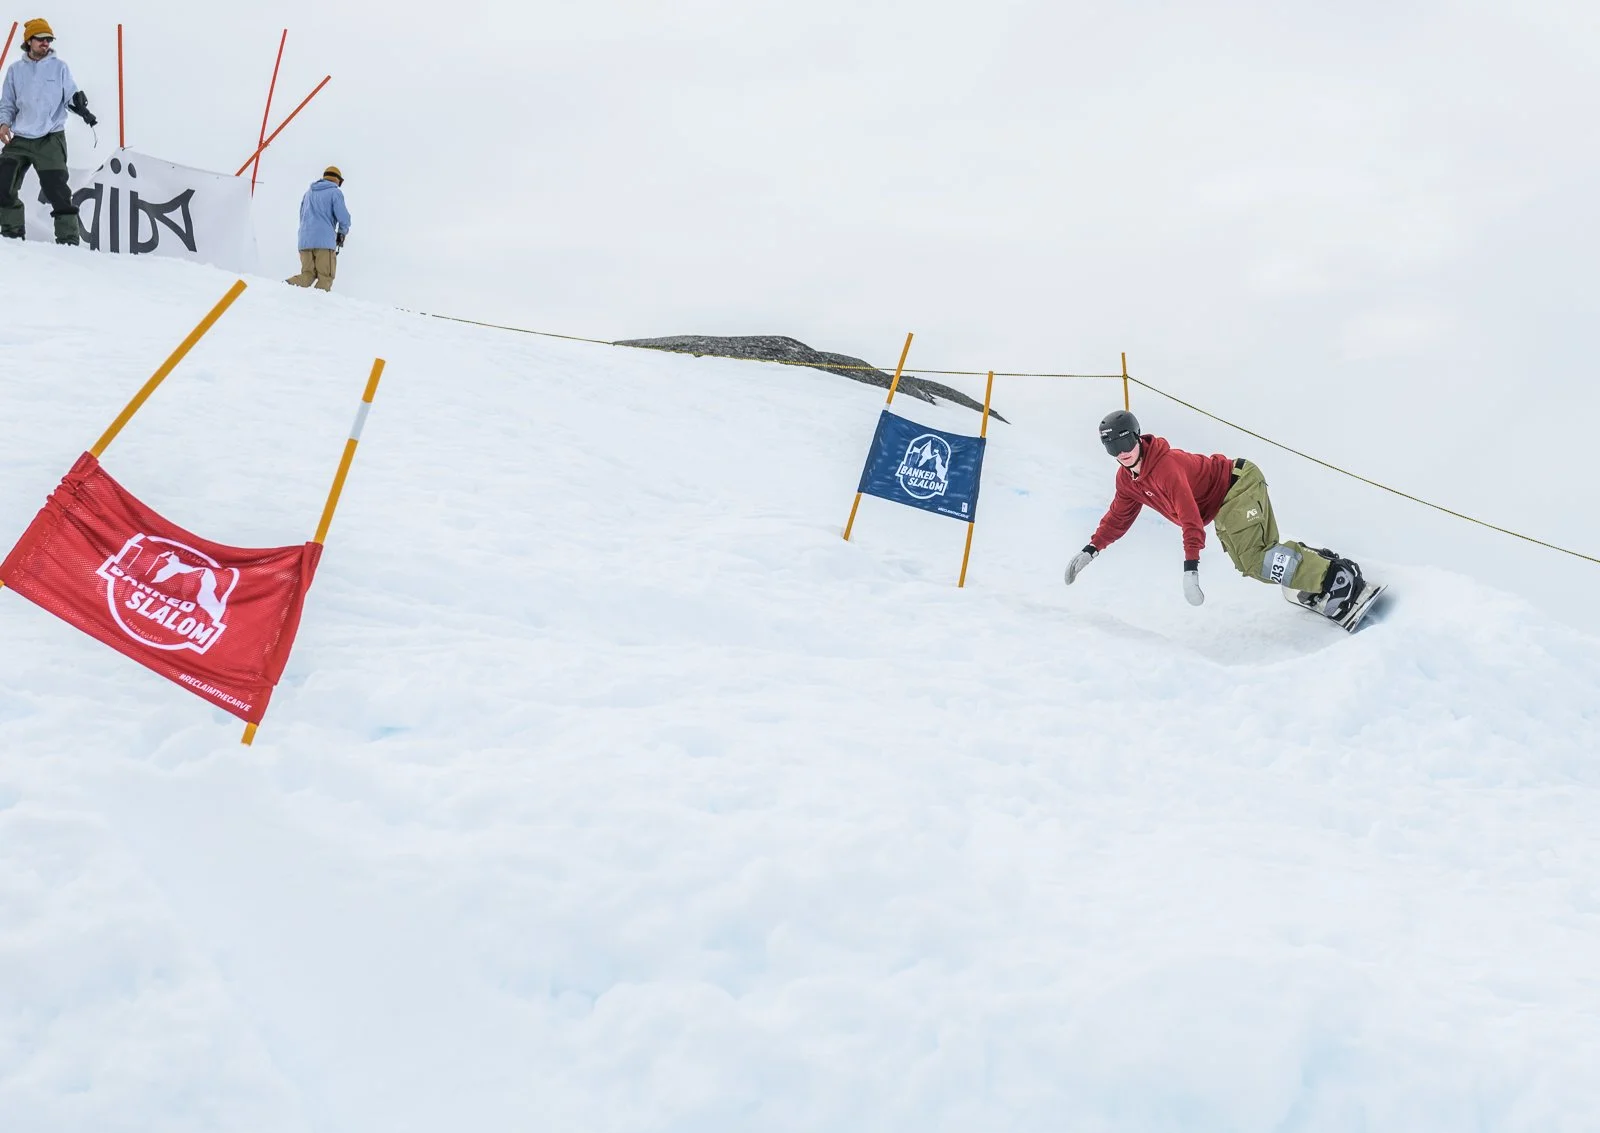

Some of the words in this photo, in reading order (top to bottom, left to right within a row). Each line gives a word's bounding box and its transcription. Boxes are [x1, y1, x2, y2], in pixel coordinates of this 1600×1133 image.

[900, 465, 936, 481] BANKED
[907, 477, 945, 492] SLALOM
[1270, 564, 1285, 584] 243
[125, 590, 215, 645] SLALOM
[179, 673, 252, 712] #RECLAIMTHECARVE
